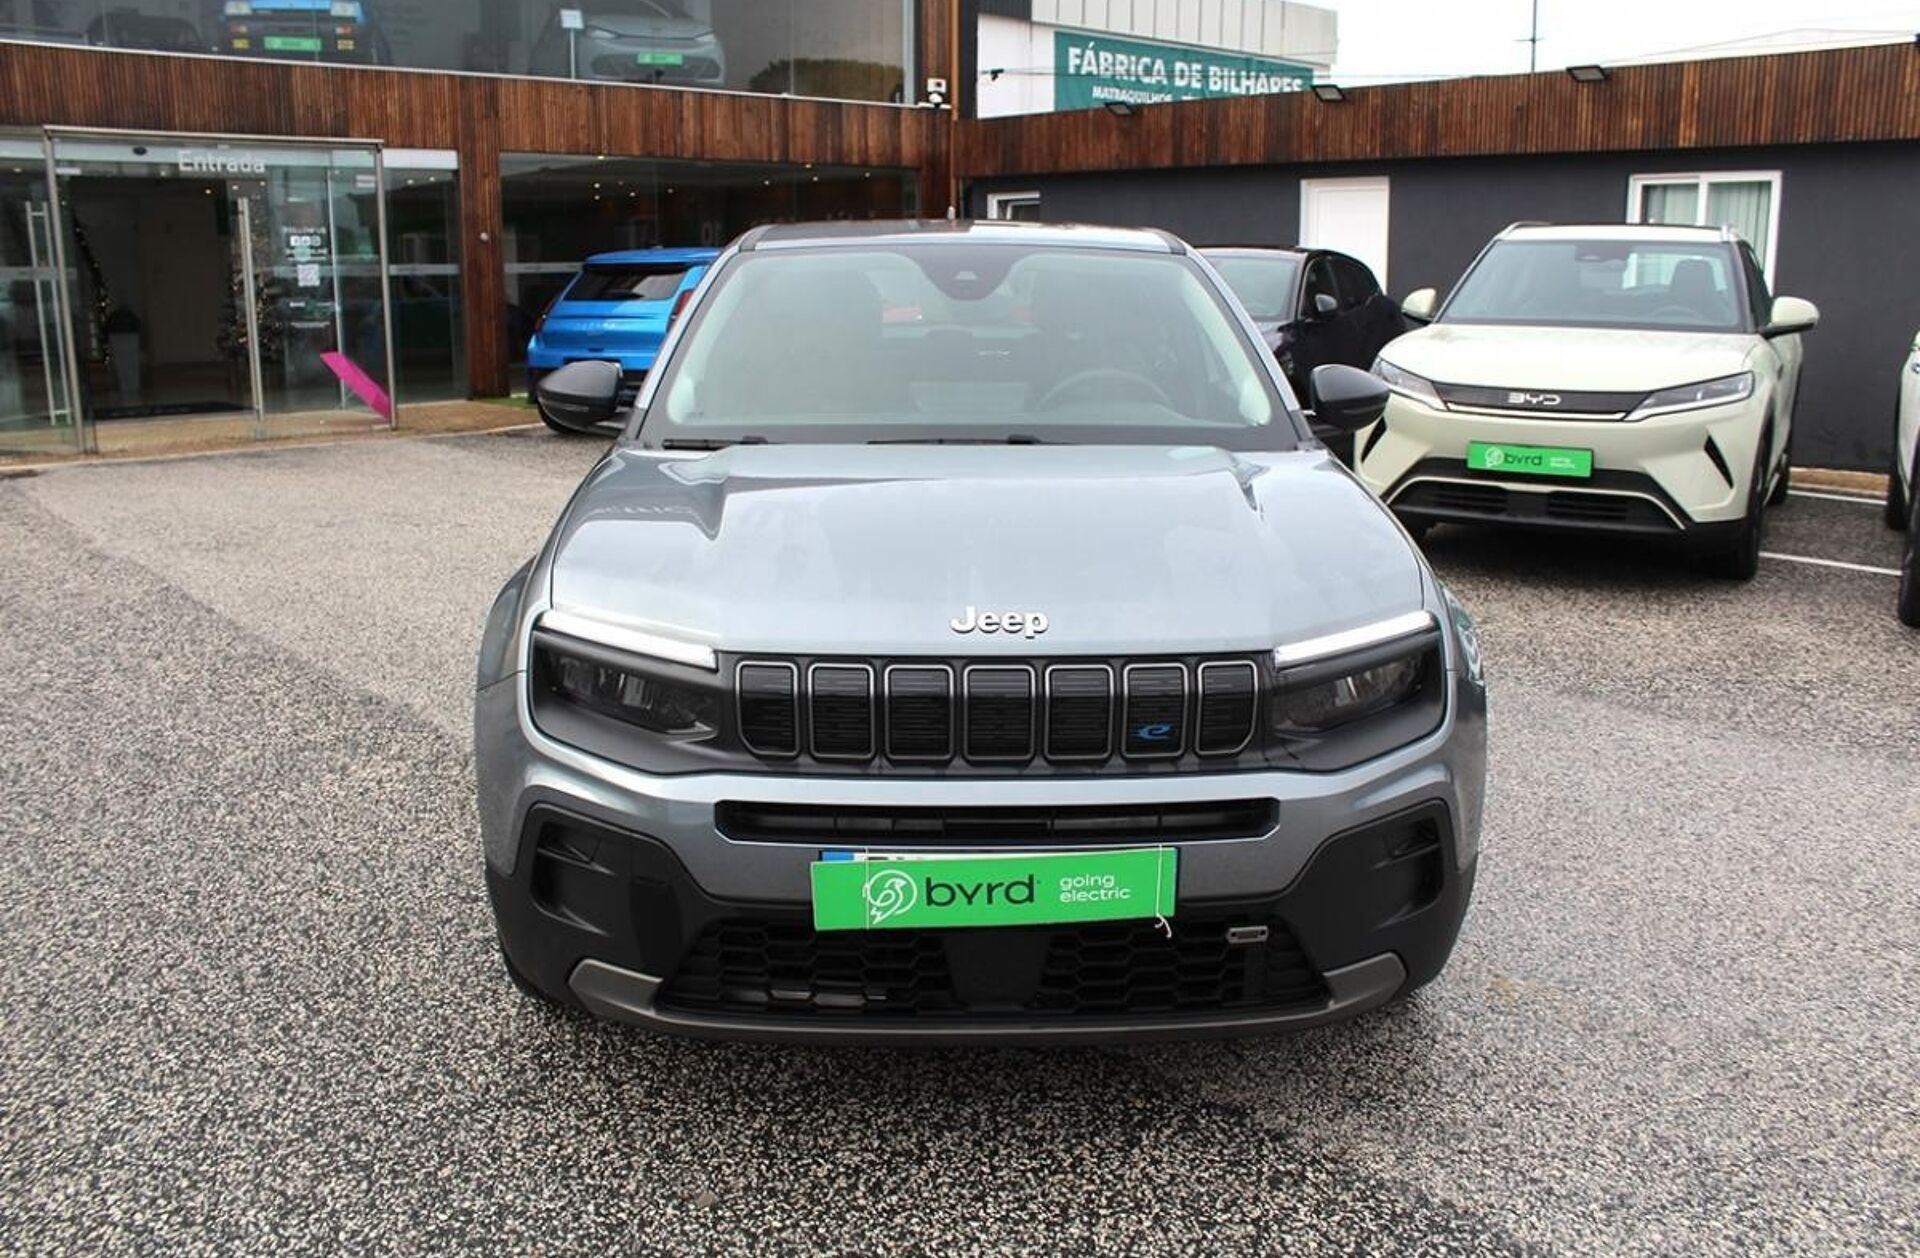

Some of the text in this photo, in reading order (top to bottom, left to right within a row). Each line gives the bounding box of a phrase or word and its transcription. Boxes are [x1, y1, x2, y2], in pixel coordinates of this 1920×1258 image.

[1067, 41, 1303, 95] FÁBRICA DE BILHARES
[178, 150, 266, 173] Entrada
[1507, 391, 1562, 405] BYD
[1503, 452, 1543, 466] byrd
[950, 605, 1050, 639] Jeep
[925, 873, 1035, 907] byrd
[1059, 873, 1115, 891] going
[1059, 887, 1131, 903] electric
